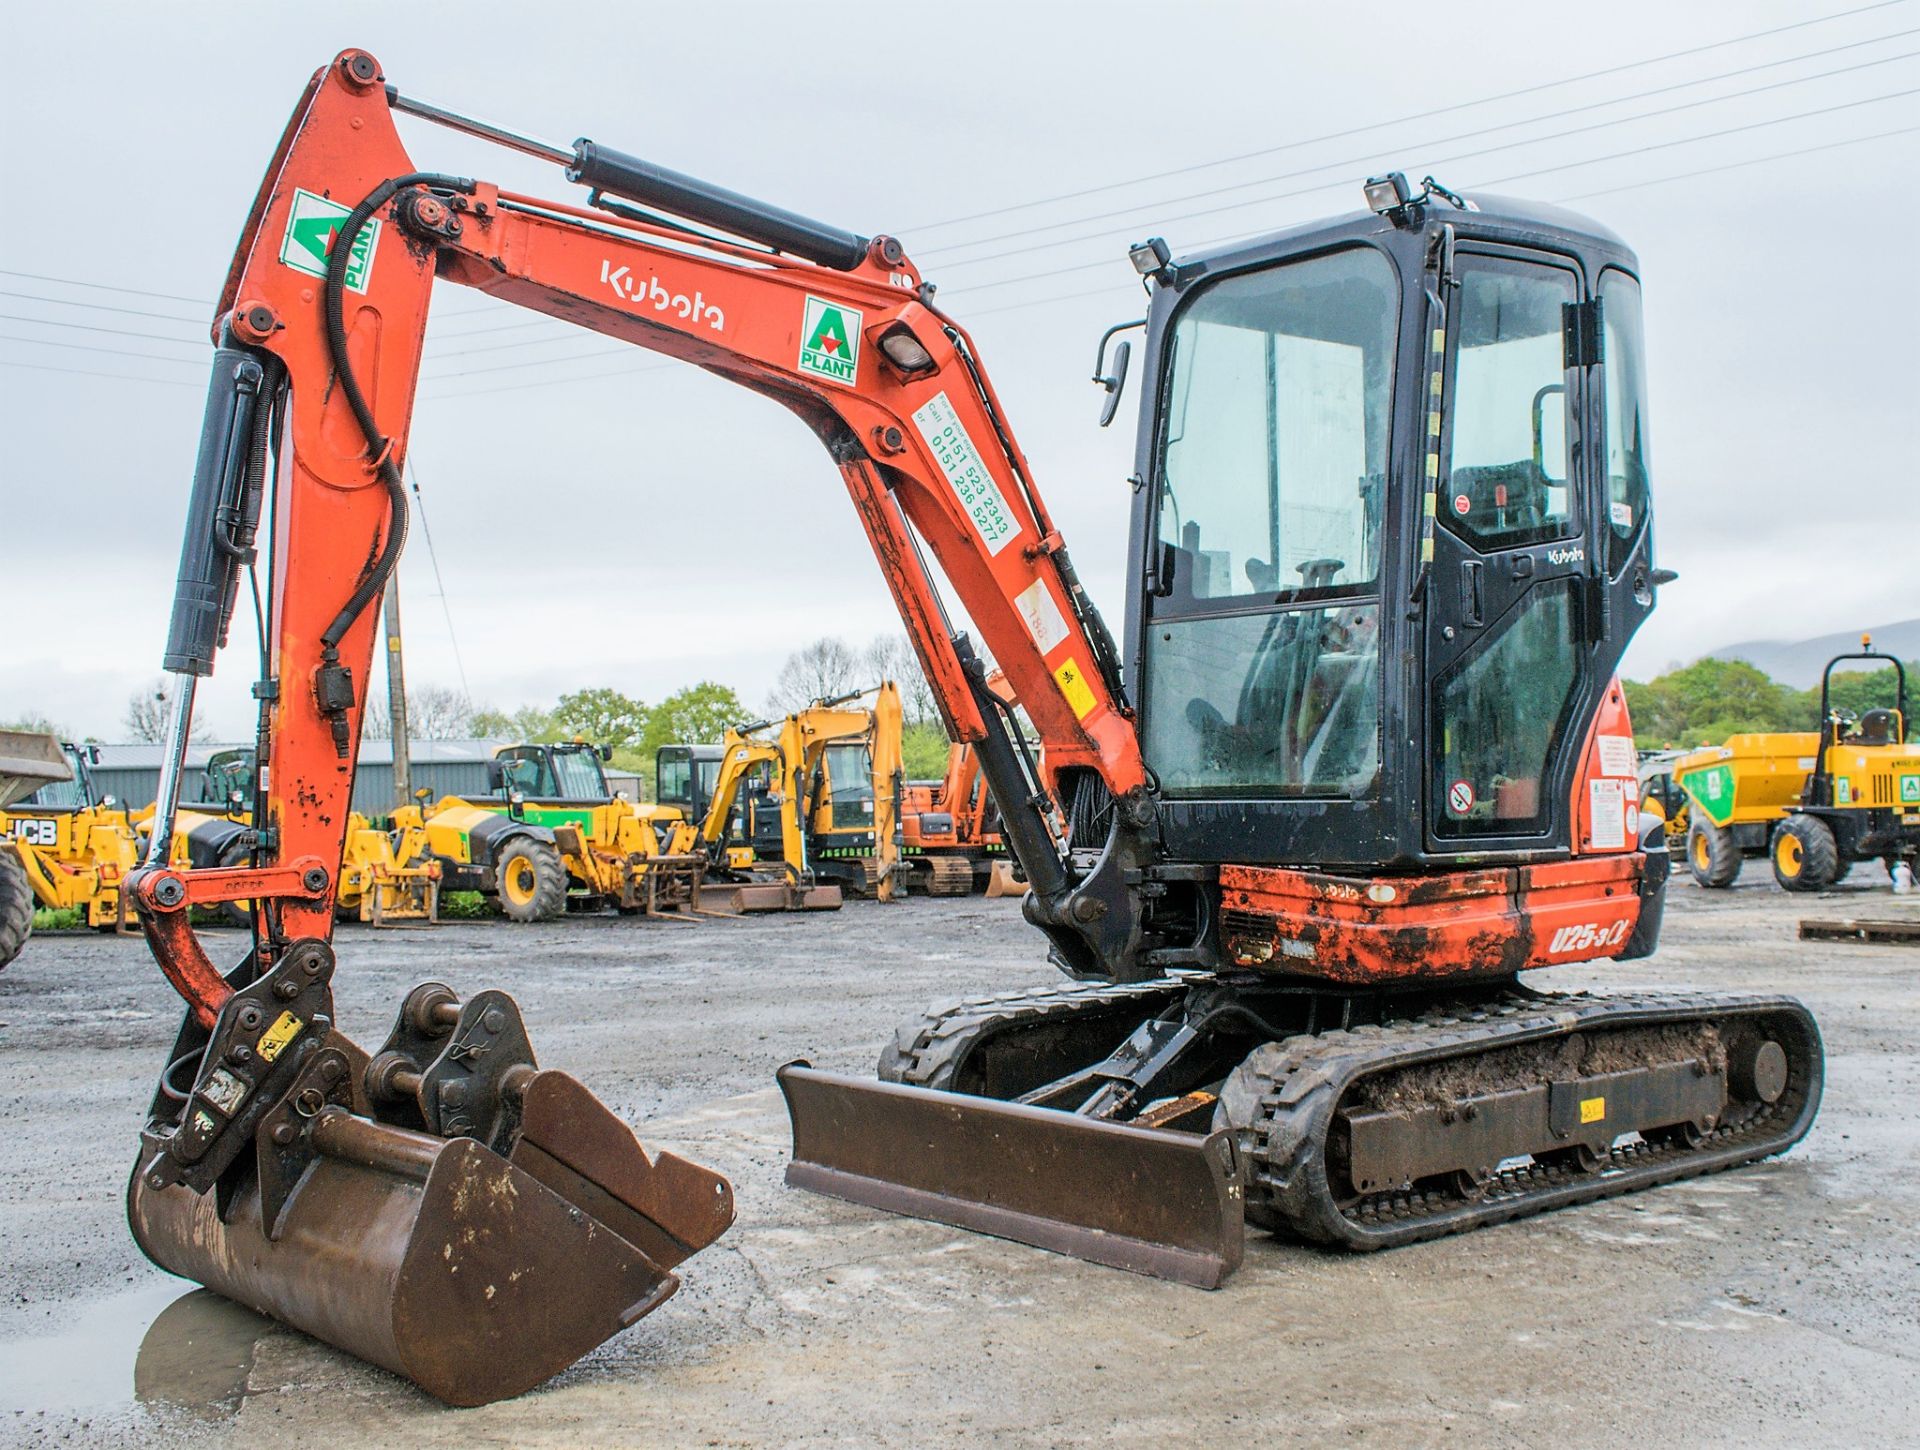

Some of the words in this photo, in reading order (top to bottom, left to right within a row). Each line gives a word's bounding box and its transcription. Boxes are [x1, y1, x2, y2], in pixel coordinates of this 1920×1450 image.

[600, 259, 725, 331] Kubota
[801, 352, 855, 379] PLANT
[807, 307, 852, 361] A
[928, 402, 942, 423] Call
[942, 426, 968, 463] 0151
[965, 466, 986, 495] 523
[983, 497, 1009, 534] 2343
[938, 395, 949, 409] For
[946, 410, 956, 420] all
[951, 420, 965, 438] your
[962, 438, 988, 479] equipment
[916, 412, 926, 423] or
[931, 435, 957, 472] 0151
[954, 476, 976, 504] 236
[972, 507, 999, 541] 5277
[1547, 547, 1584, 565] Kubota
